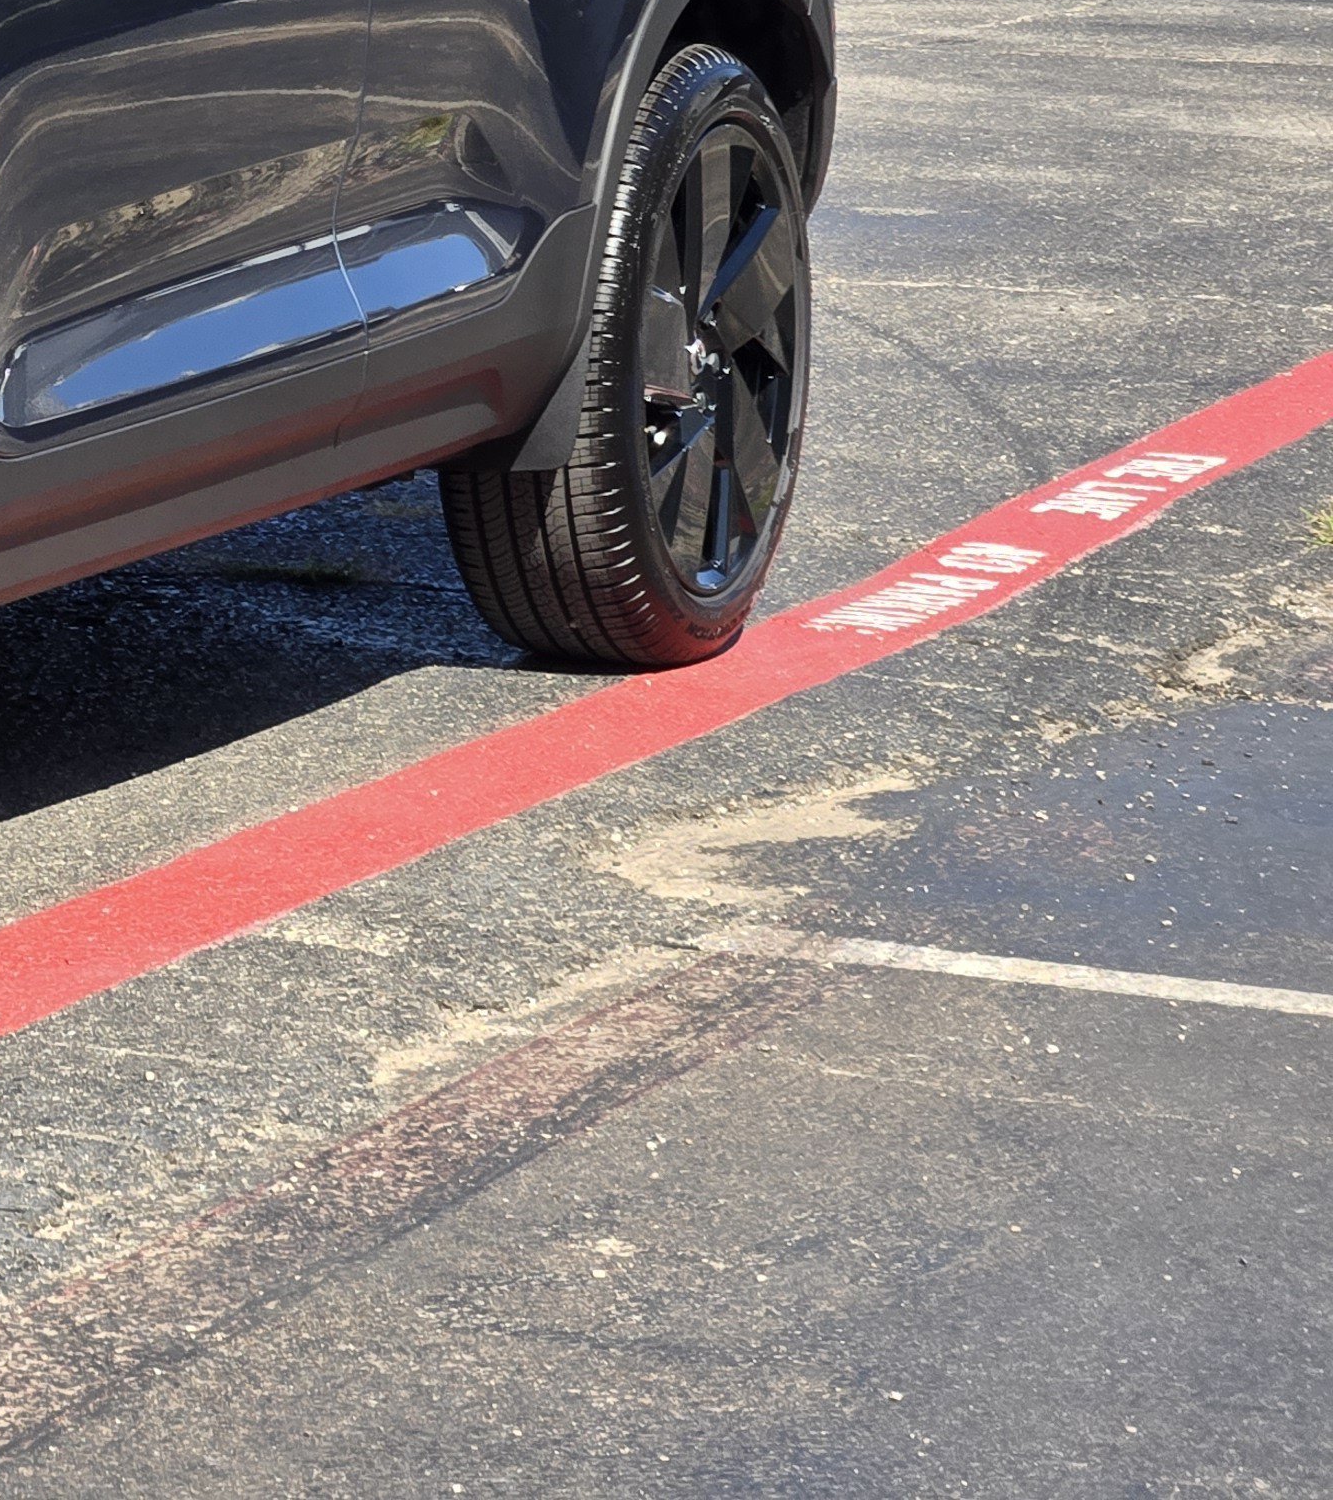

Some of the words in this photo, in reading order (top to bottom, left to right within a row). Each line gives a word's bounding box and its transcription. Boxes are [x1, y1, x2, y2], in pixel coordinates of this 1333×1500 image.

[1104, 451, 1228, 484] FIRE
[1030, 480, 1168, 521] LANE
[937, 541, 1047, 574] NO
